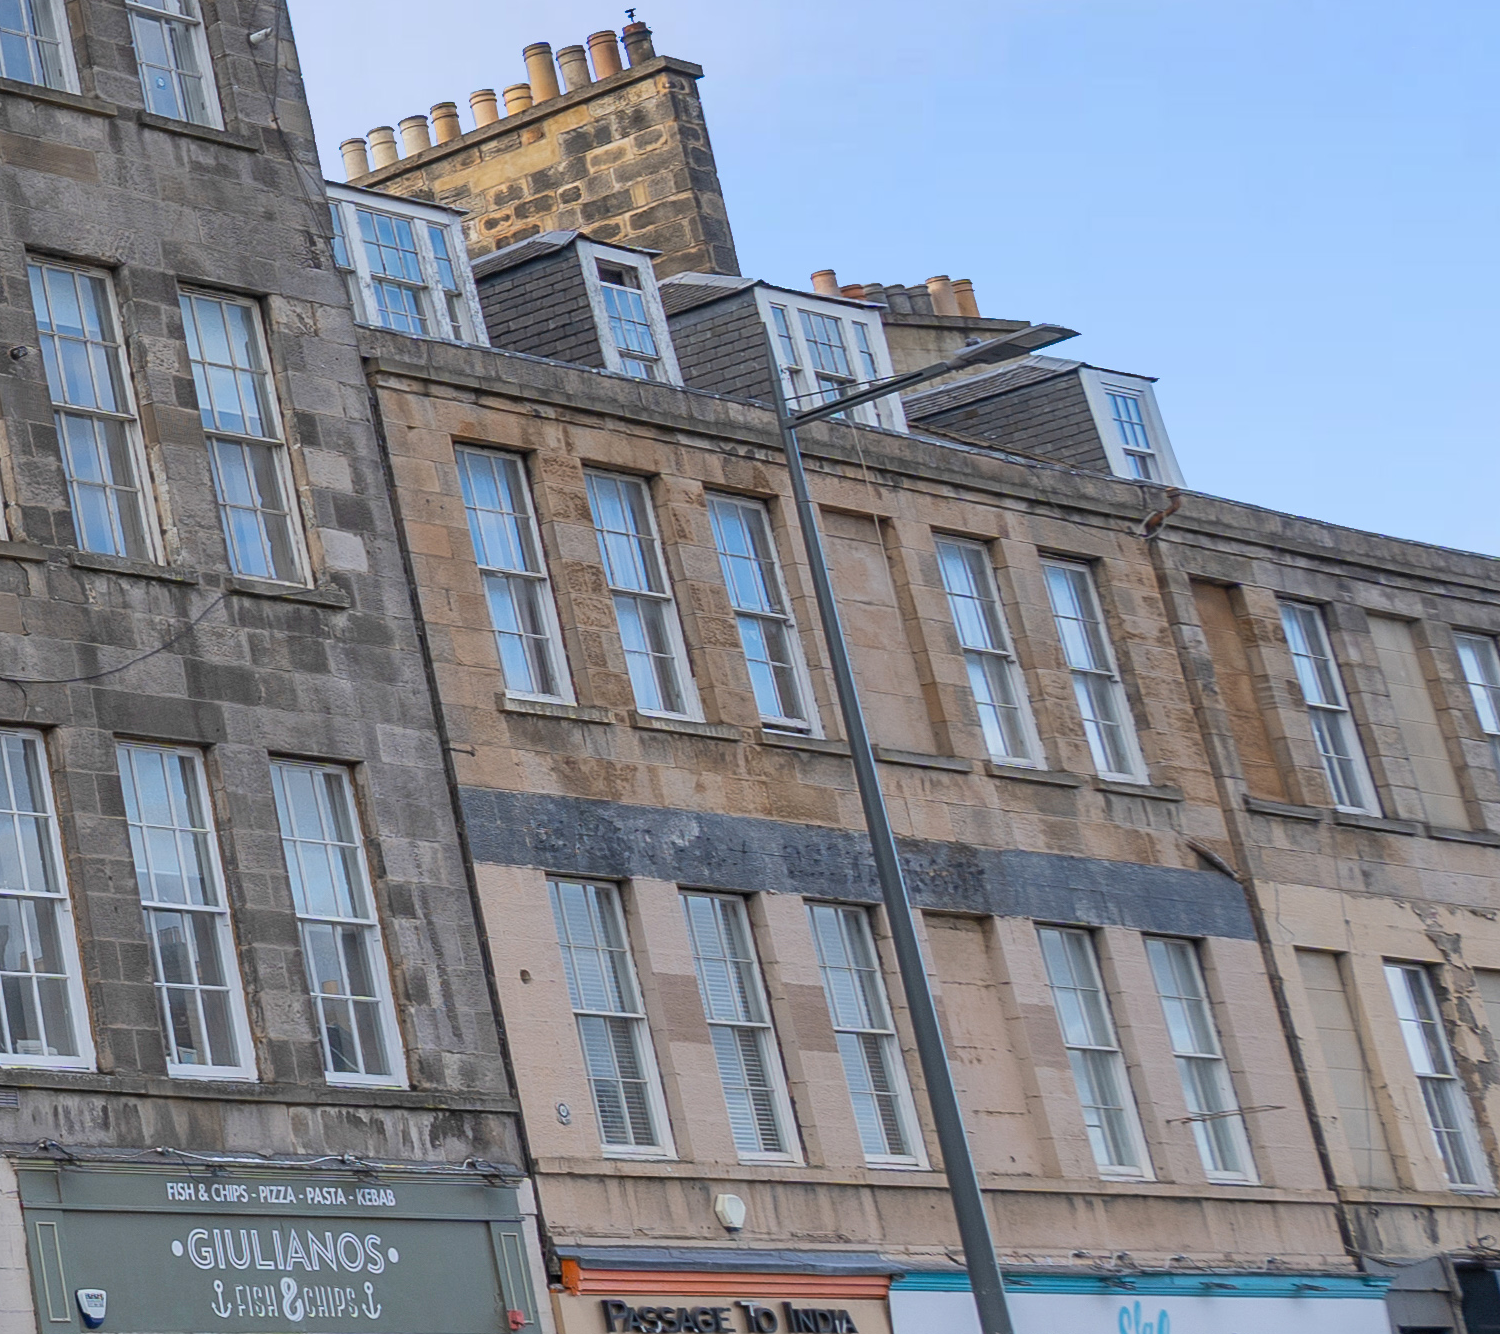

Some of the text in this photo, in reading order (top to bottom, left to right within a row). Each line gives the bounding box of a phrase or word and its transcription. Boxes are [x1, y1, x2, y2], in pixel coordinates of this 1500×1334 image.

[166, 1183, 195, 1201] FISH
[198, 1184, 210, 1201] &
[211, 1183, 249, 1203] CHIPS
[259, 1185, 297, 1204] PIZZA
[306, 1187, 347, 1205] PASTA
[355, 1188, 396, 1206] KEBAB
[187, 1228, 385, 1274] GIULIANOS
[235, 1276, 359, 1322] FISH & CHIPS
